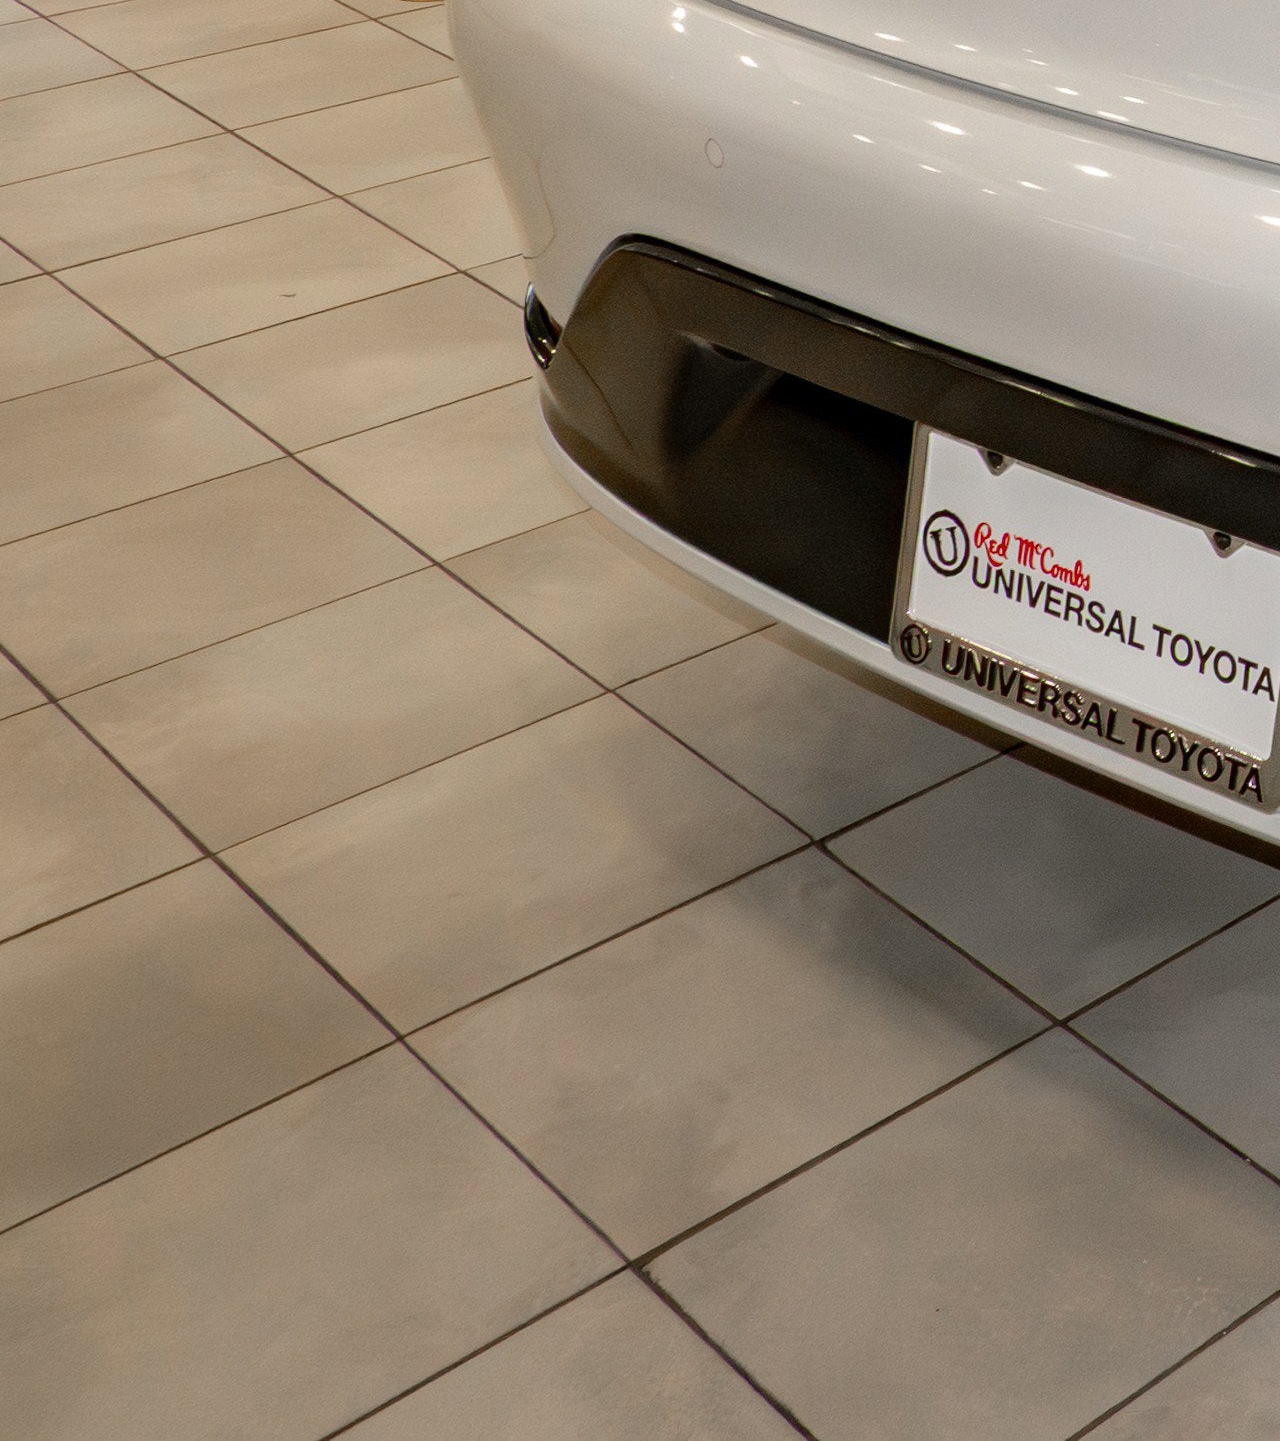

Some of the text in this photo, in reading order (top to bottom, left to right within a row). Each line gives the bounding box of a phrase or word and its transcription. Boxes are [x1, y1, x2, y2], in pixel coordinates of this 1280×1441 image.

[971, 556, 1276, 703] UNIVERSAL TOYOTA
[973, 521, 1010, 569] Red
[1014, 535, 1092, 592] McCombs
[940, 638, 1126, 746] UNIVERSAL
[1132, 717, 1264, 803] TOYOTA
